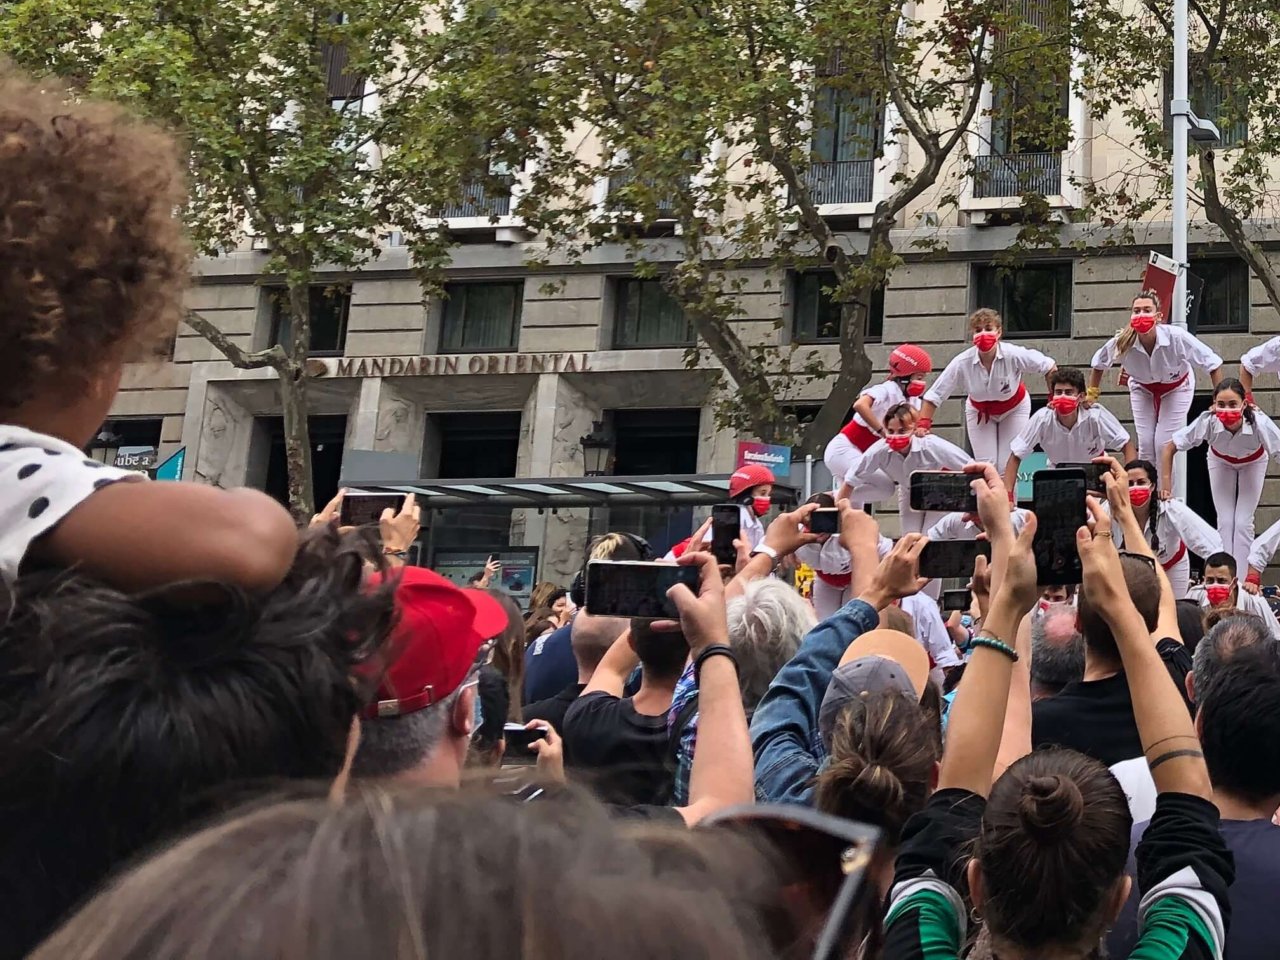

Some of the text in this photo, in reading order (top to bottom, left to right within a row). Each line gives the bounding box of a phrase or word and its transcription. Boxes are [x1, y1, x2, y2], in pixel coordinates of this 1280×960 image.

[336, 353, 593, 377] MANDARIN ORIENTAL
[115, 453, 139, 466] ube
